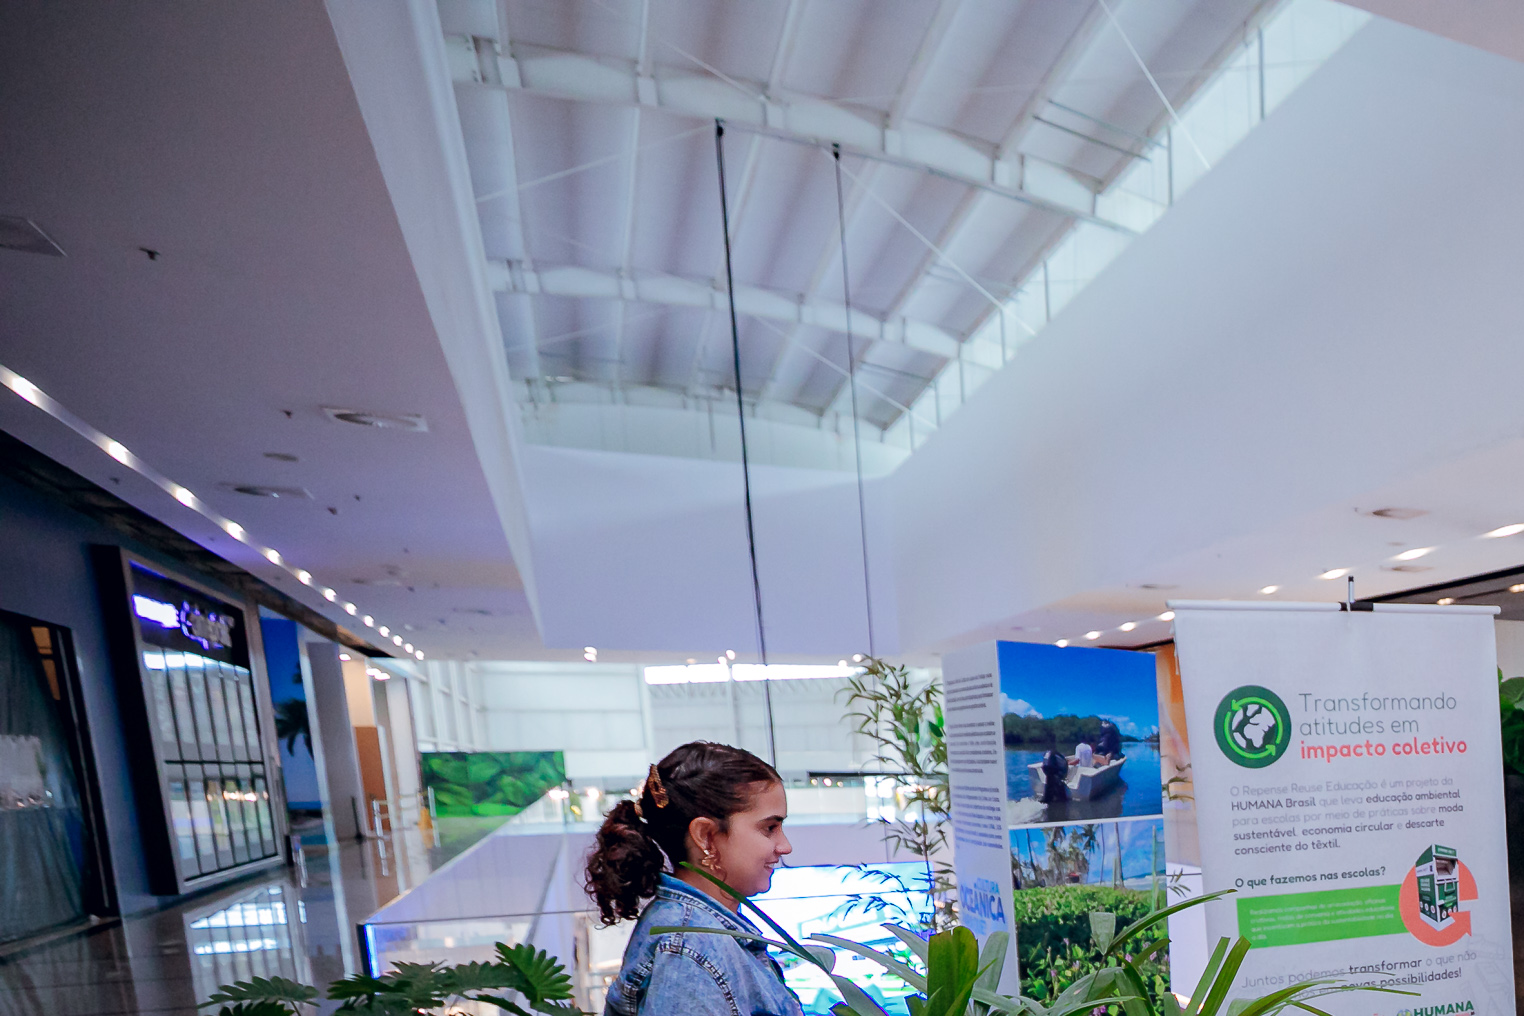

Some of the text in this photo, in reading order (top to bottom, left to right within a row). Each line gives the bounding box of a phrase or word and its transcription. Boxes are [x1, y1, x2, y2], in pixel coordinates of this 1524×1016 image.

[1298, 691, 1457, 712] Transformando
[1299, 716, 1420, 736] atitudes em
[1300, 736, 1467, 763] impacto coletivo
[1230, 786, 1239, 797] O
[1242, 785, 1288, 797] Repense
[1290, 782, 1323, 793] Reuse
[1325, 780, 1378, 793] Educação
[1389, 780, 1404, 788] um
[1406, 777, 1439, 789] projeto
[1441, 776, 1454, 786] da
[1231, 788, 1461, 811] HUMANA Brasil que leva educação ambiental
[1231, 803, 1464, 828] para escolas por meio de práticas sobre moda
[1301, 822, 1352, 836] economia
[1354, 821, 1394, 832] circular
[1396, 822, 1403, 830] e
[1405, 818, 1445, 829] descarte
[1234, 843, 1292, 856] consciente
[1294, 841, 1309, 851] do
[1234, 866, 1386, 890] O que fazemos nas escolas?
[1241, 951, 1477, 989] Juntos podemos transformar o que não
[1379, 967, 1462, 989] possibilidades!
